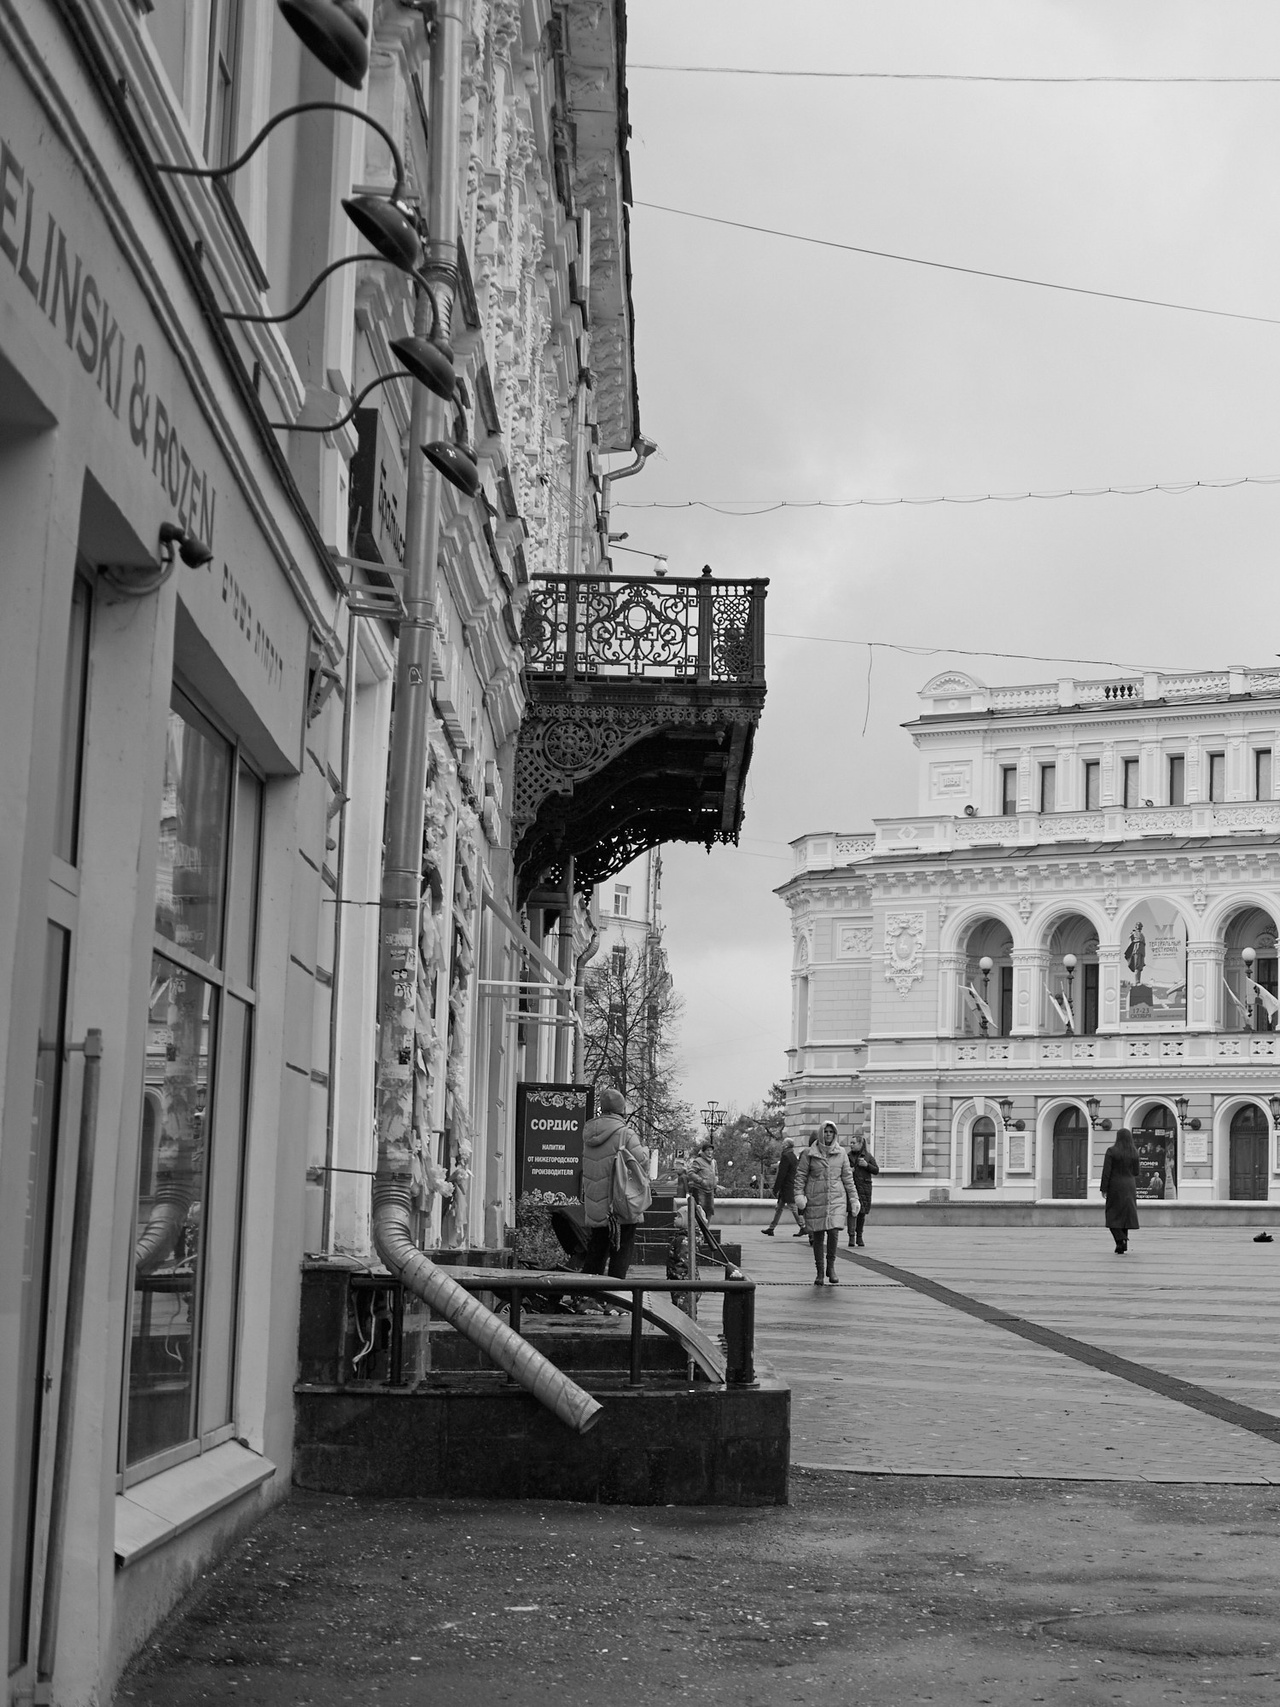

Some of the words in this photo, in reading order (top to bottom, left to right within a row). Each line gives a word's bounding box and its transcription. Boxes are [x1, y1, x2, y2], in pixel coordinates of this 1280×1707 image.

[129, 343, 150, 459] &
[152, 394, 216, 572] ROZEN
[530, 1119, 578, 1131] СОРДИС
[532, 1168, 574, 1176] ПРОИЗВОДИТЕЛЯ
